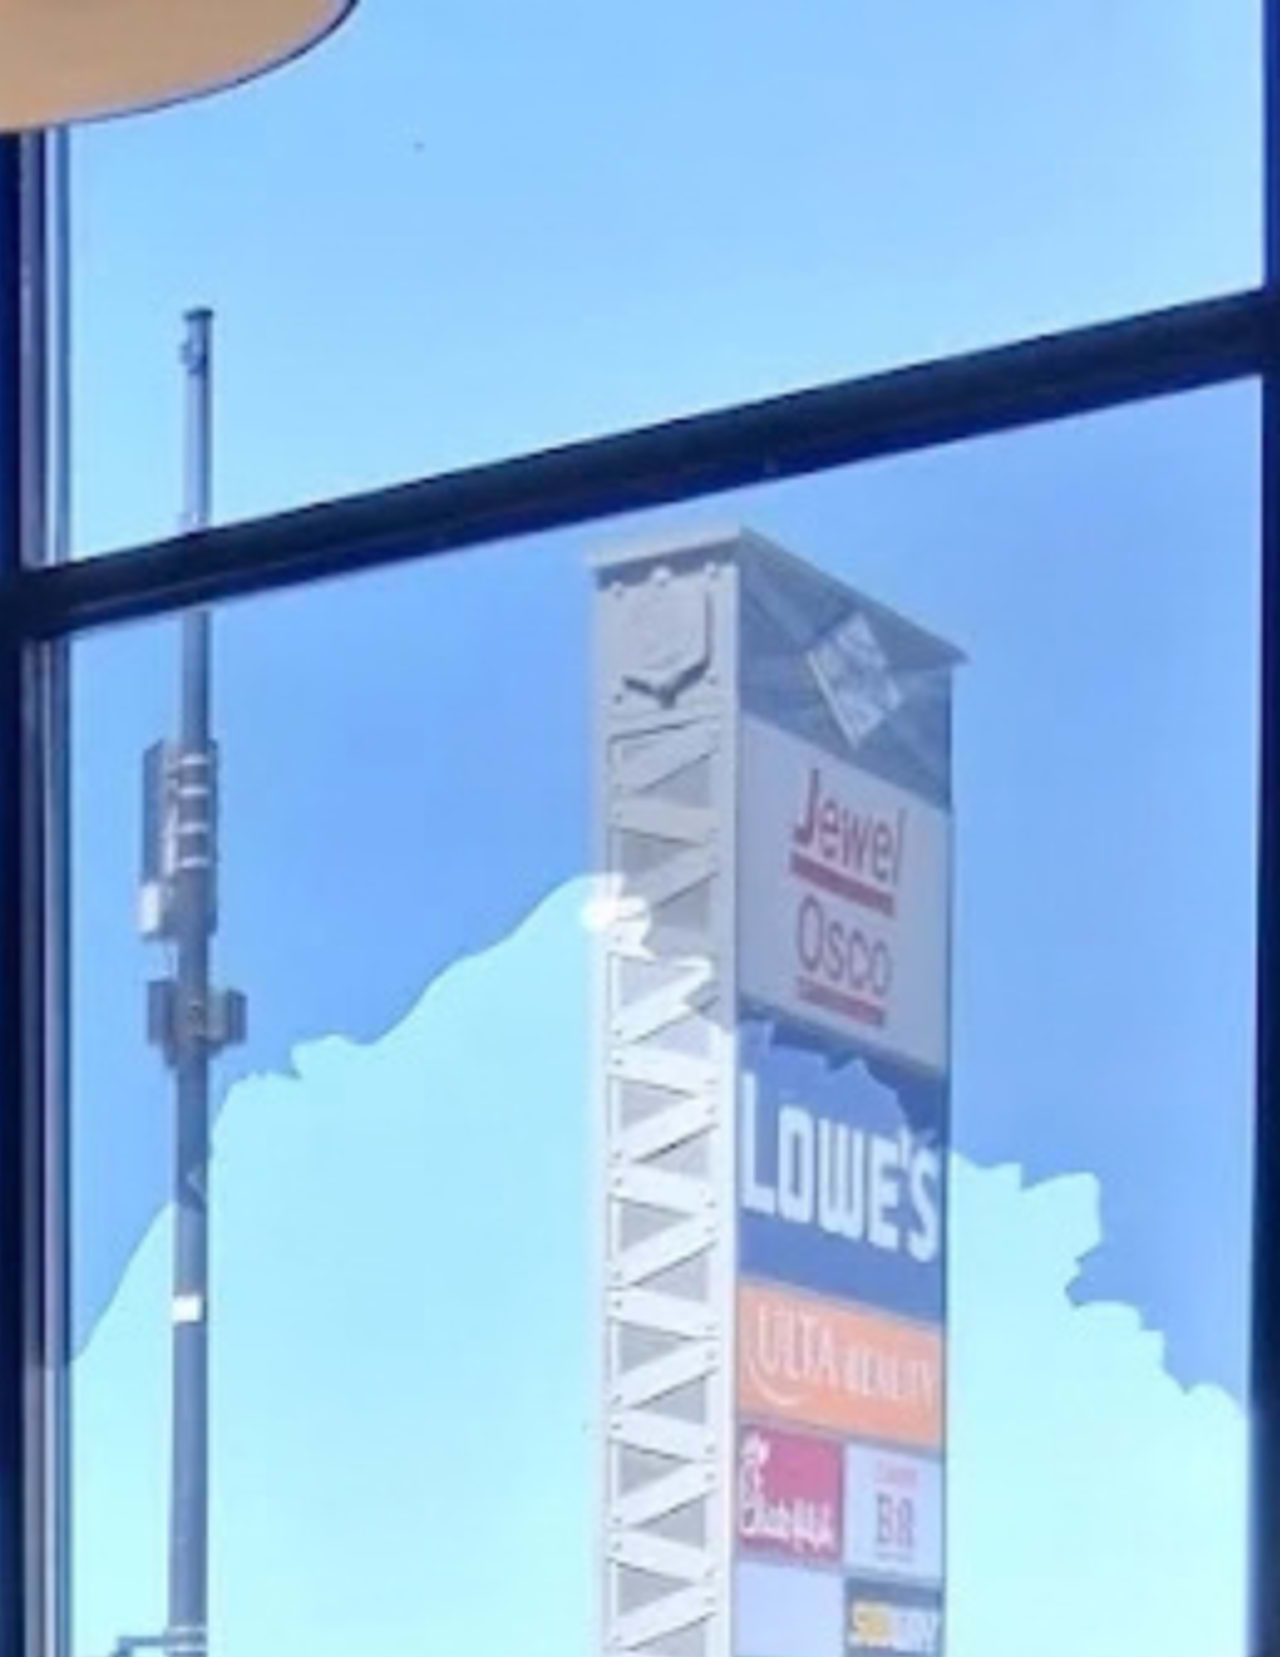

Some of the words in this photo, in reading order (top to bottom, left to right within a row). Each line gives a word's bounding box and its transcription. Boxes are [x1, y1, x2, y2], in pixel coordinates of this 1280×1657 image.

[791, 768, 903, 887] Jewel
[796, 895, 890, 996] Osco
[740, 1071, 939, 1263] LOWE'S
